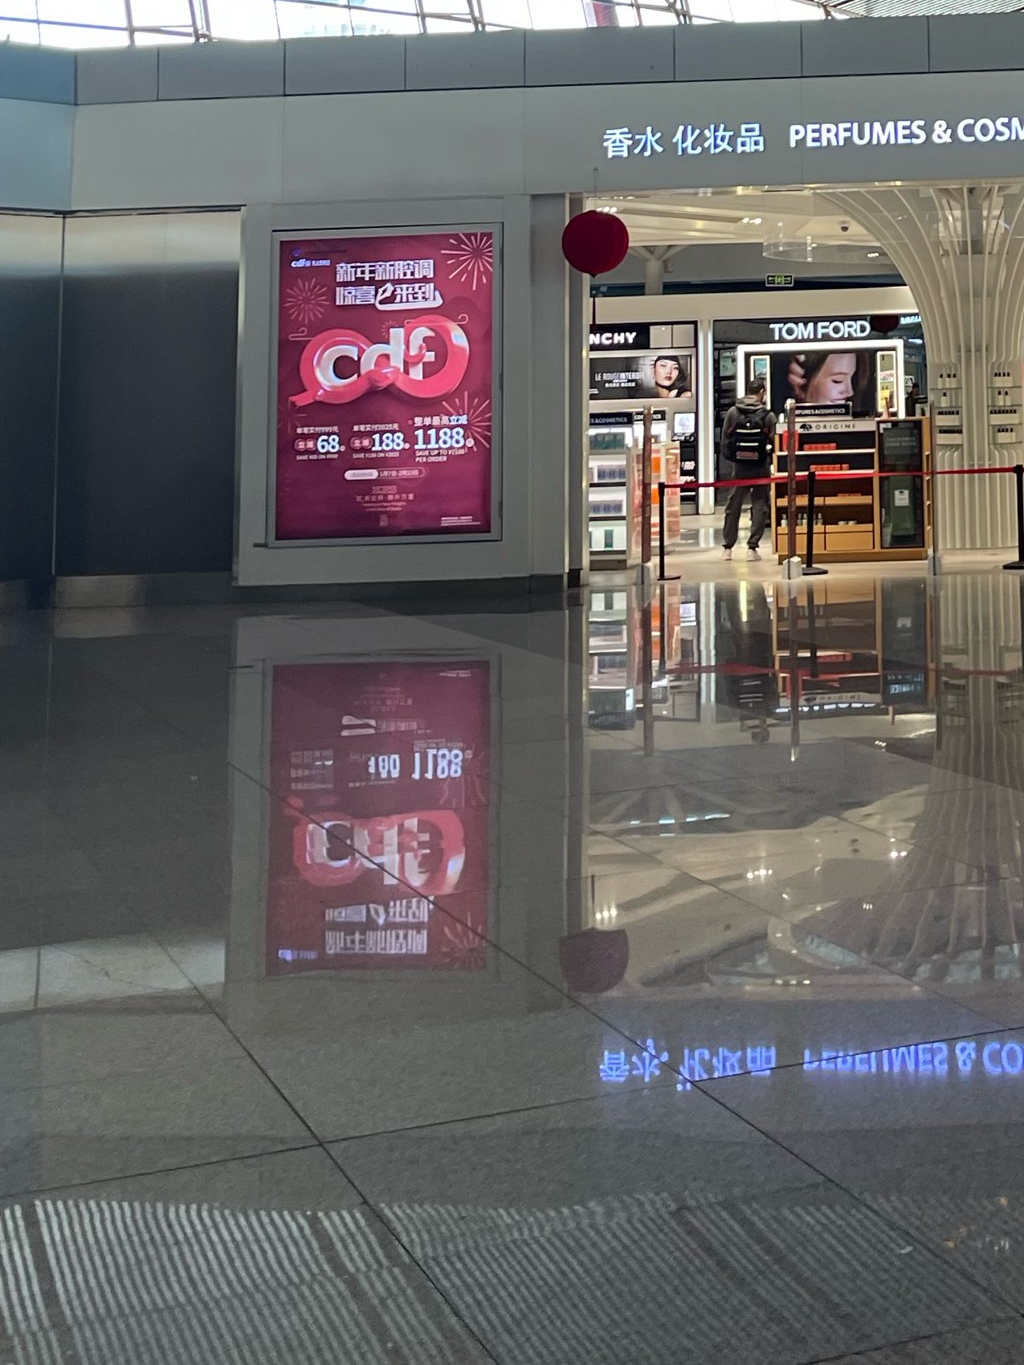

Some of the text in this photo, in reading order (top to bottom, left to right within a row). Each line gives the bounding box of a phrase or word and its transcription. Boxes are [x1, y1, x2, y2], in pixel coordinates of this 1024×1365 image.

[602, 123, 765, 159] 香水 化妆品
[789, 119, 926, 148] PERFUMES
[932, 119, 953, 144] &
[336, 259, 435, 282] 新年新腔调
[769, 320, 871, 340] TOM FORD
[814, 422, 857, 431] ORIGINS
[317, 435, 339, 453] 68
[371, 432, 405, 451] 188
[414, 427, 465, 449] 1188
